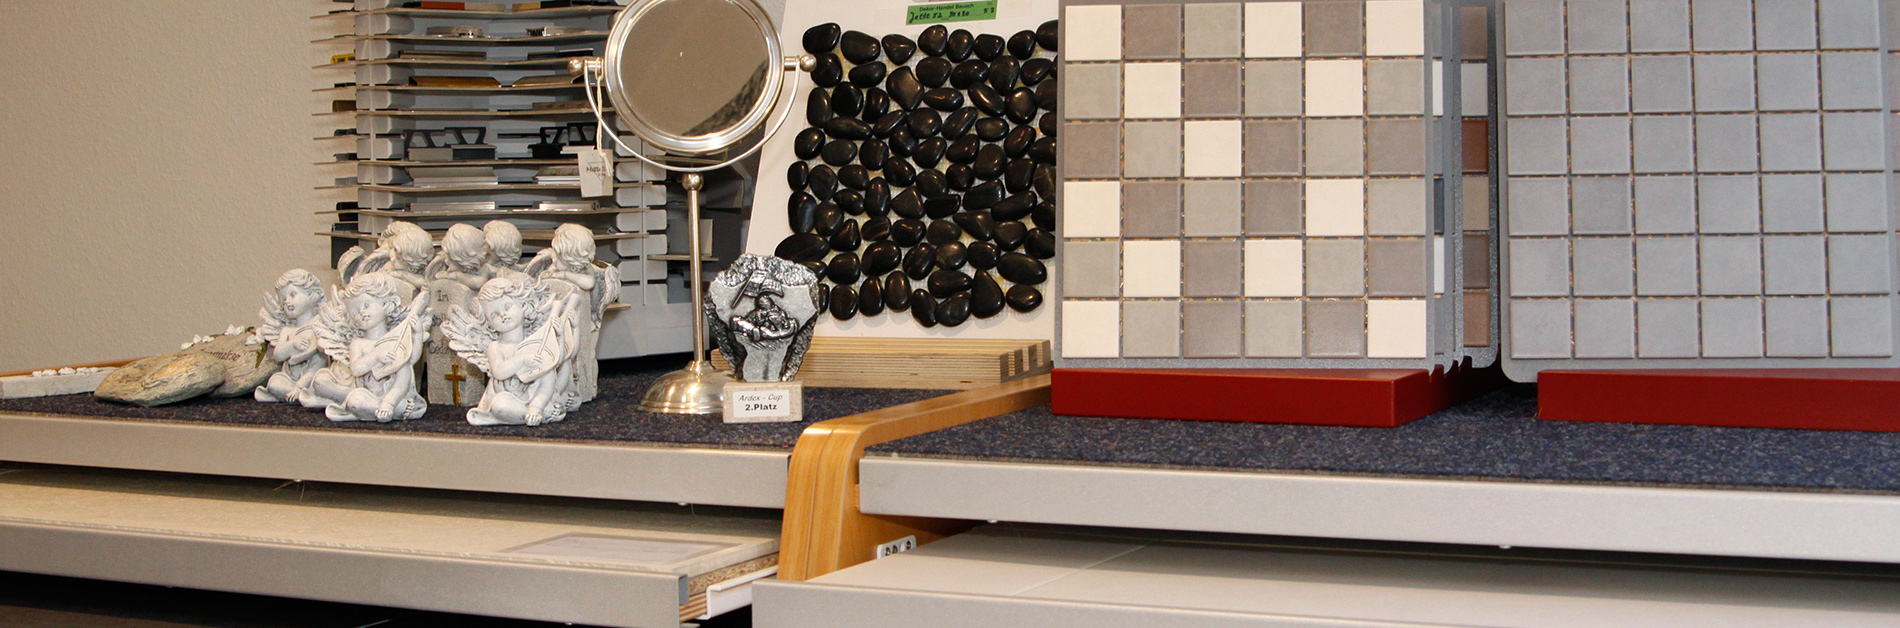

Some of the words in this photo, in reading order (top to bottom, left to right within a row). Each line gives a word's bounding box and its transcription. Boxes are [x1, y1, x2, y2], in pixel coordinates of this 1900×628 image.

[738, 394, 760, 402] Ardex
[767, 393, 783, 402] Cup
[745, 403, 777, 411] 2.Platz
